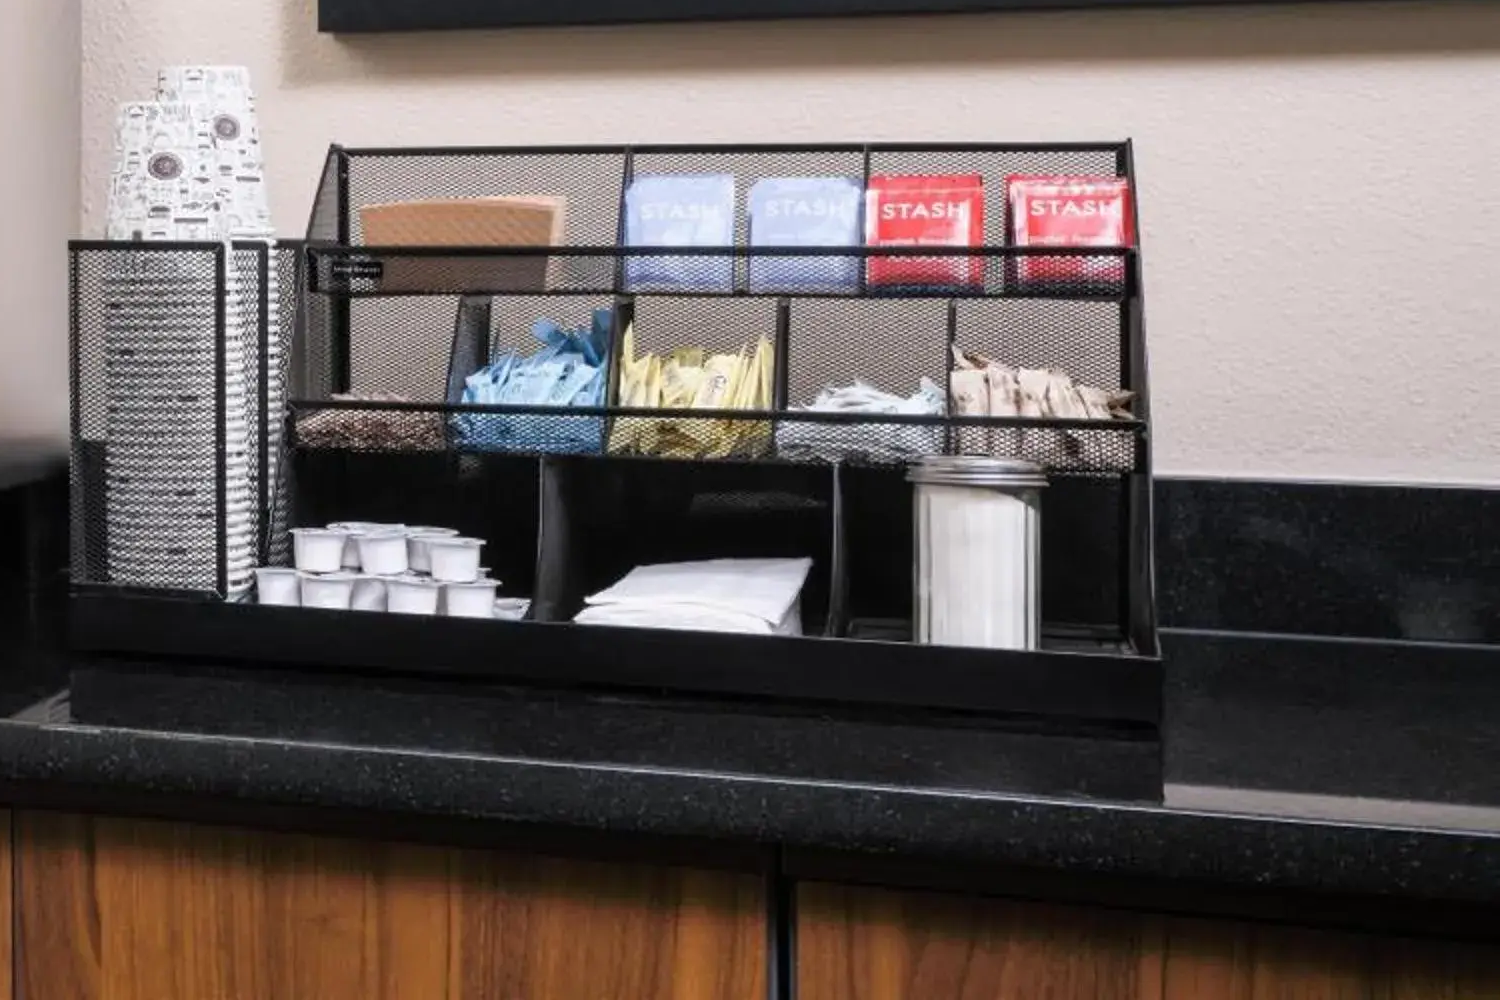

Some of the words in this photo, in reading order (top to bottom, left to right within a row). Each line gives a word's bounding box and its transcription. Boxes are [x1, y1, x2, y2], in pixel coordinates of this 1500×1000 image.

[640, 203, 720, 221] STASH
[765, 199, 846, 217] STASH
[882, 201, 965, 220] STASH
